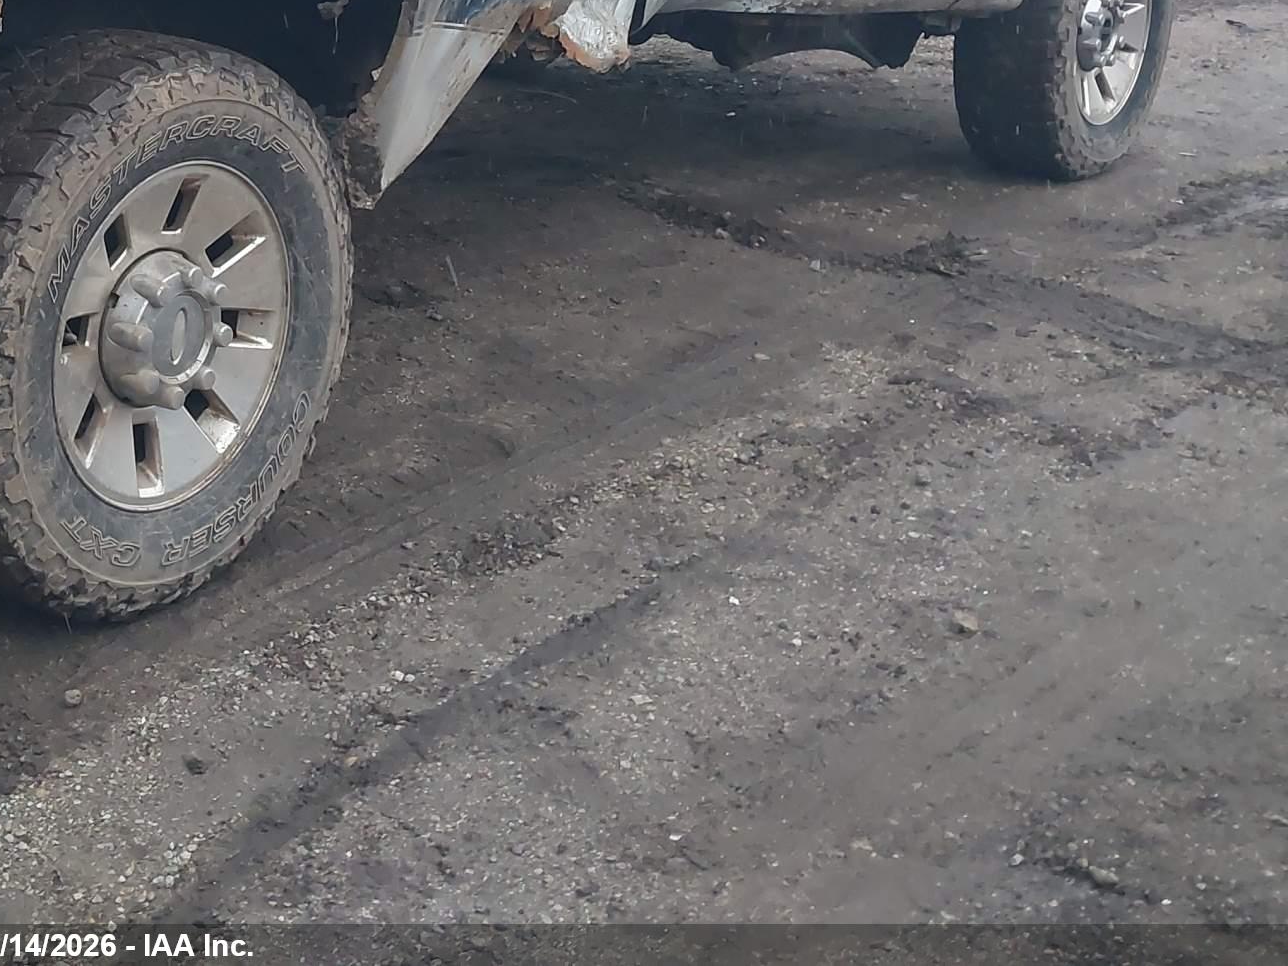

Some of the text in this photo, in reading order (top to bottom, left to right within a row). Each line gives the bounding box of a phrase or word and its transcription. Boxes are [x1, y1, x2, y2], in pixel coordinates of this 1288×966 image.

[47, 114, 306, 304] MASTERCRAFT
[60, 391, 312, 568] COURSER CXT
